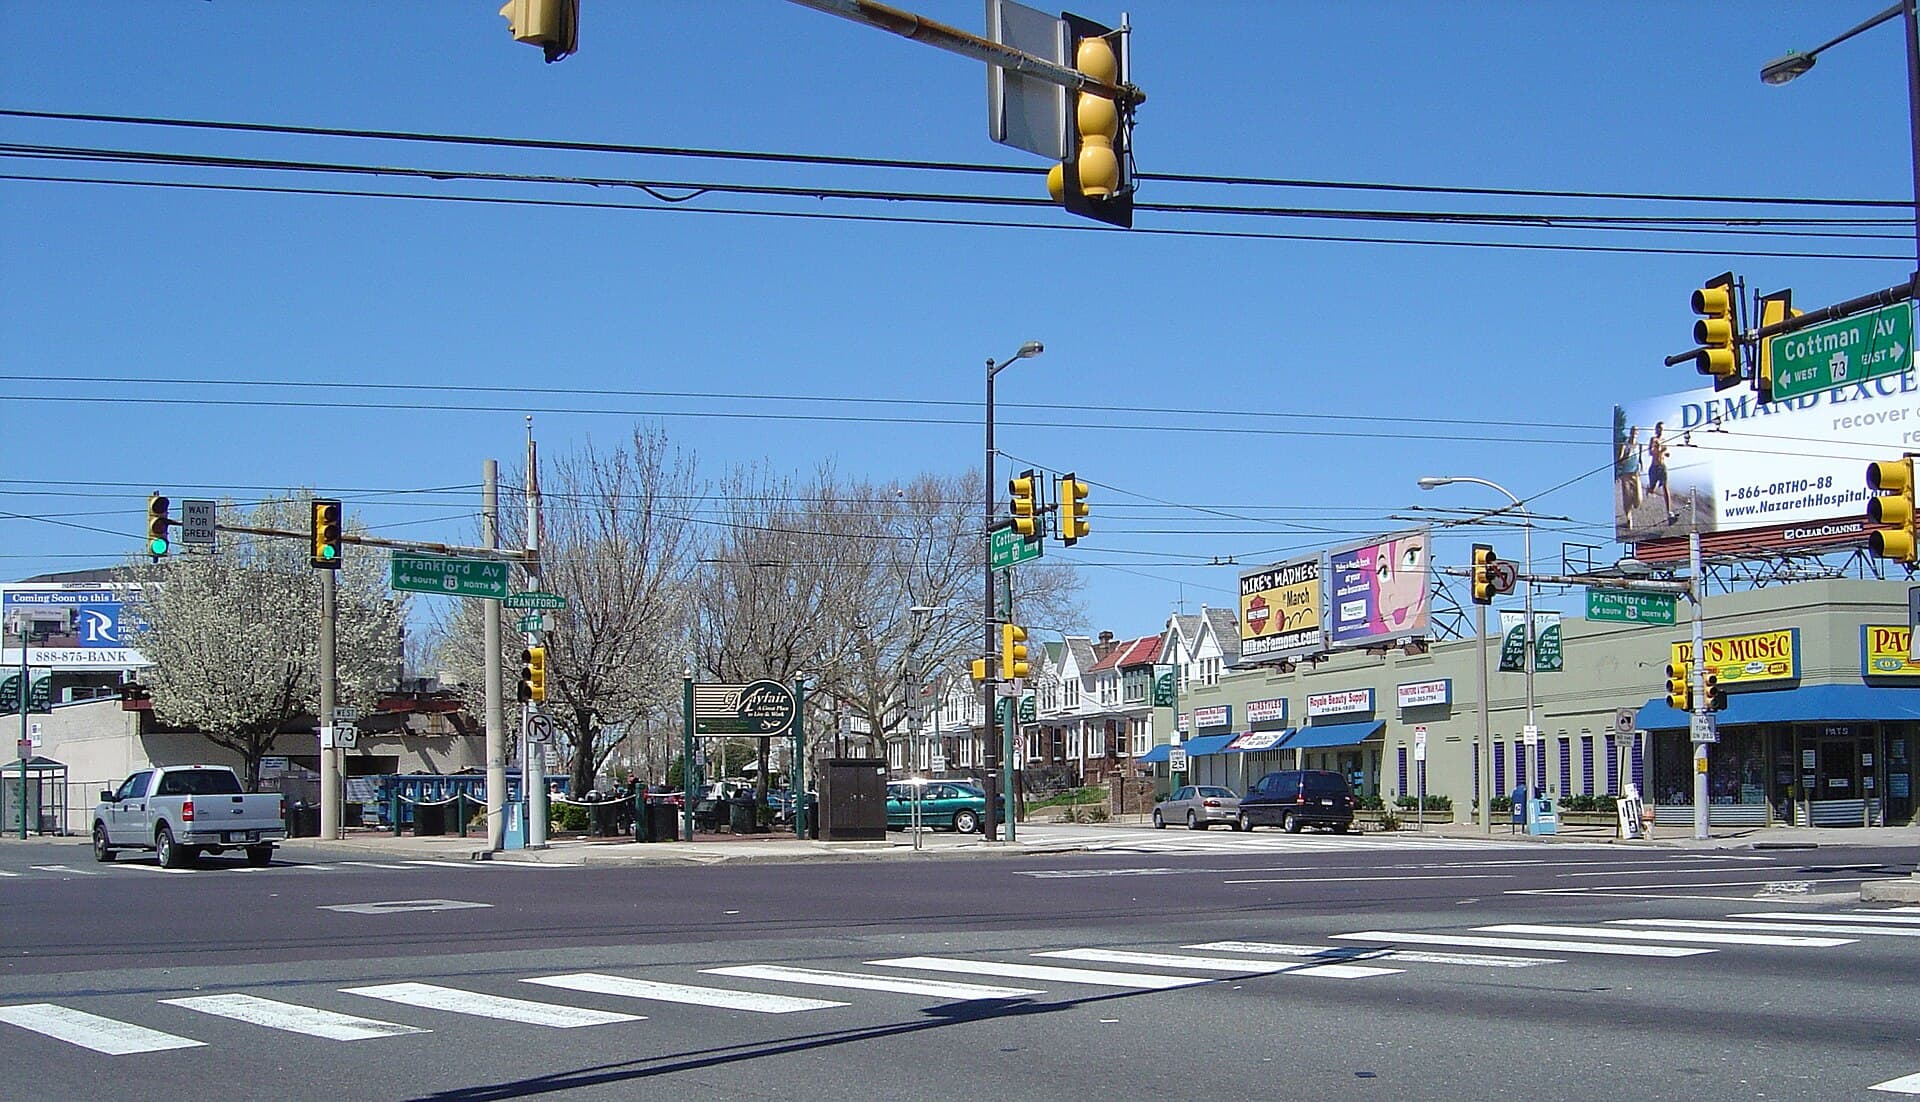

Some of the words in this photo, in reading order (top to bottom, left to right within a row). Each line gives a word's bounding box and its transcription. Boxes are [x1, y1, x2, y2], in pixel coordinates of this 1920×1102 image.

[1785, 326, 1861, 361] Cottman
[1873, 317, 1896, 340] Av
[1795, 366, 1818, 383] WEST
[1831, 360, 1847, 379] 73
[1861, 349, 1887, 366] EAST
[1832, 407, 1910, 431] recover
[1725, 476, 1833, 502] 1-866-ORTHO-88
[188, 506, 210, 515] WAIT
[190, 517, 208, 526] FOR
[184, 529, 214, 538] GREEN
[401, 560, 471, 575] Frankford
[481, 565, 500, 578] Av
[412, 576, 438, 585] SOUTH
[445, 577, 456, 587] 13
[463, 580, 489, 589] NORTH
[1242, 574, 1273, 595] MIKE'S
[1274, 563, 1319, 587] MADNESS
[12, 593, 50, 604] Coming
[51, 593, 76, 603] Soon
[78, 594, 89, 602] to
[90, 593, 110, 602] this
[508, 597, 558, 608] FRANKFORD
[1287, 587, 1310, 608] March
[1592, 591, 1648, 606] Frankford
[1655, 596, 1670, 607] Av
[35, 651, 128, 662] 888-875-BANK
[720, 687, 788, 713] Mayfair
[1310, 696, 1327, 708] Royale
[1328, 694, 1347, 705] Beauty
[1348, 691, 1368, 704] Supply
[335, 709, 356, 717] WEST
[335, 727, 355, 742] 73
[1171, 760, 1185, 769] 25
